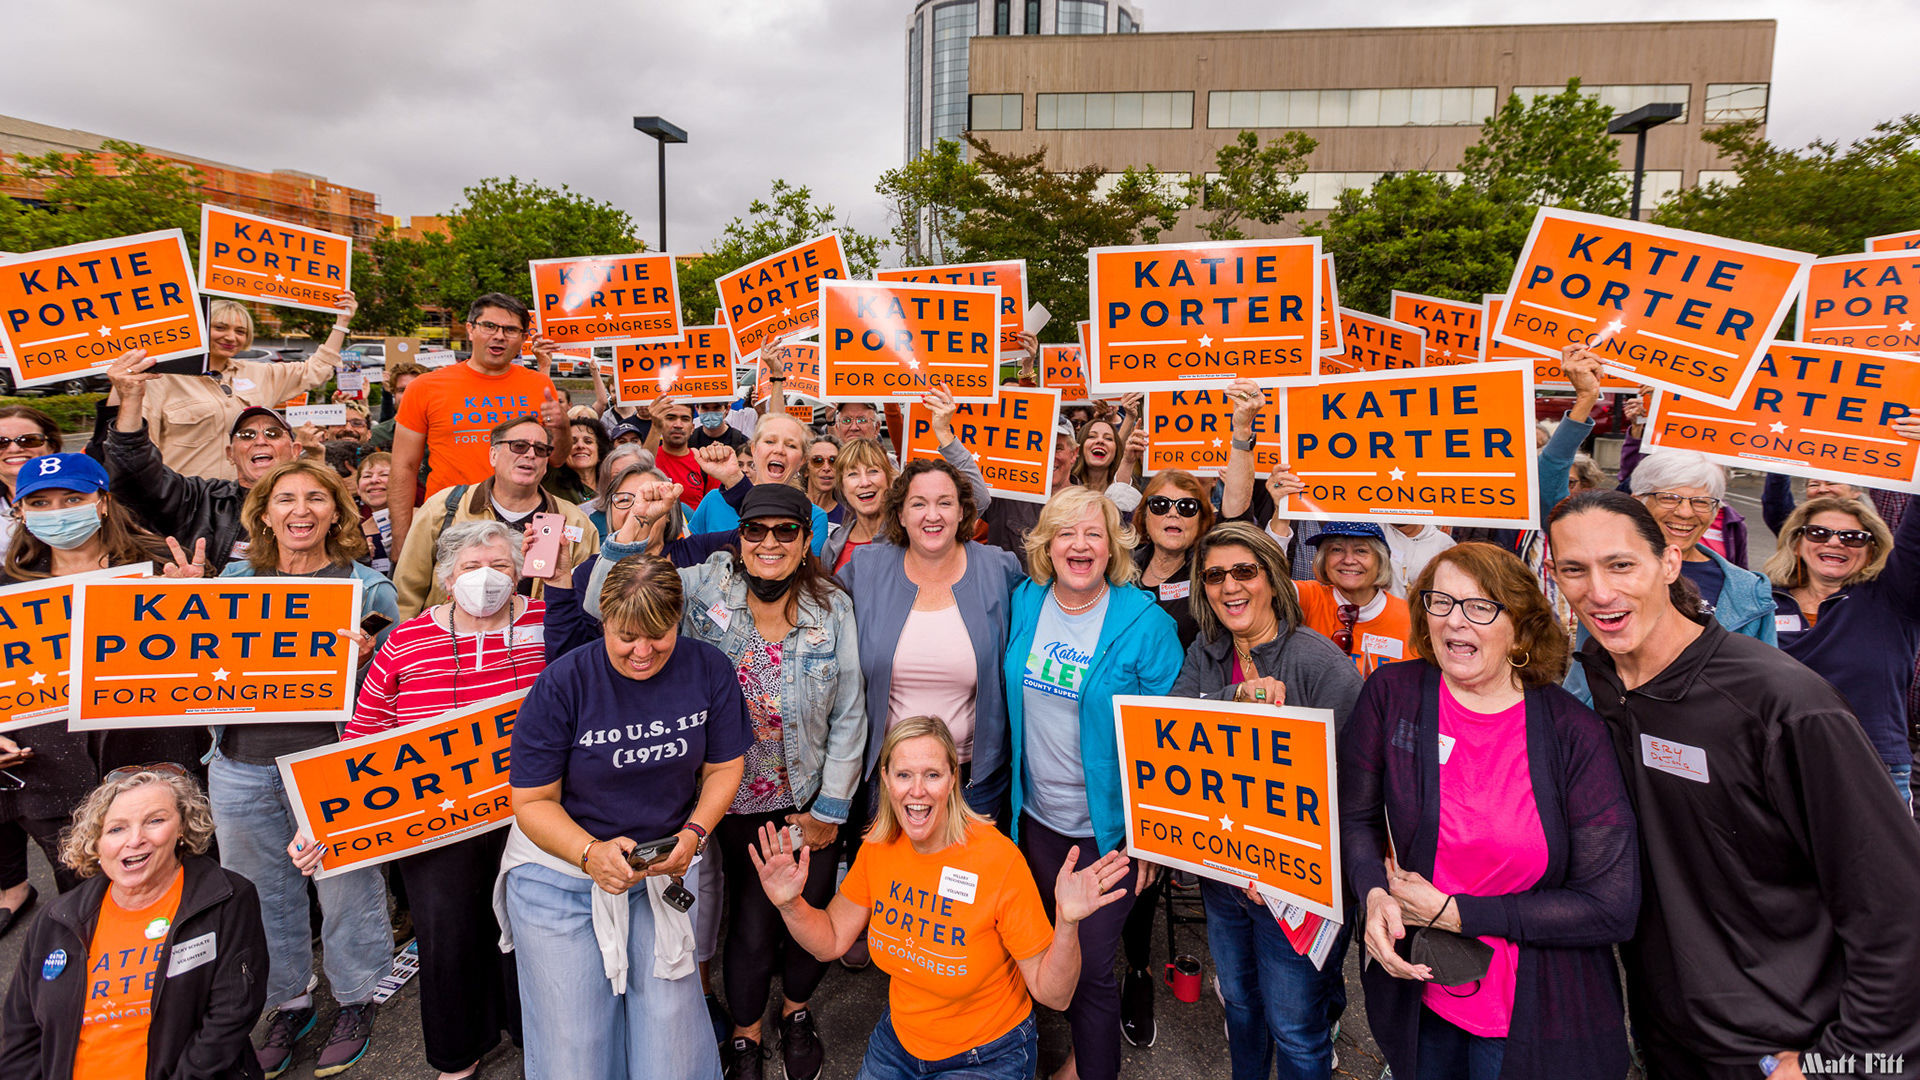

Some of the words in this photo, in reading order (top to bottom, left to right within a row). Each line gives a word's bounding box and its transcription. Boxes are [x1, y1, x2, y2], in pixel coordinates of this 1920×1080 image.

[234, 222, 326, 256] KATIE
[20, 252, 152, 295] KATIE
[214, 241, 341, 281] PORTER
[558, 263, 650, 285] KATIE
[739, 249, 819, 293] KATIE
[1134, 255, 1278, 288] KATIE
[1568, 233, 1744, 293] KATIE
[212, 273, 246, 288] FOR
[254, 281, 340, 303] CONGRESS
[545, 286, 670, 311] PORTER
[732, 267, 838, 322] PORTER
[1527, 261, 1755, 342] PORTER
[8, 282, 184, 333] PORTER
[857, 295, 970, 322] KATIE
[1108, 294, 1305, 329] PORTER
[1414, 304, 1476, 329] KATI
[1814, 294, 1909, 319] POR
[548, 325, 580, 336] FOR
[585, 318, 673, 334] CONGRESS
[740, 329, 763, 347] FOR
[767, 308, 819, 334] CONGR
[835, 328, 988, 354] PORTER
[1347, 322, 1402, 351] ATIE
[24, 350, 68, 368] FOR
[76, 326, 191, 358] CONGRESS
[782, 347, 814, 360] ATI
[1109, 353, 1157, 370] FOR
[1167, 348, 1303, 368] CONGRESS
[1513, 313, 1558, 337] FOR
[1567, 328, 1729, 383] CONGRESS
[622, 353, 726, 373] PORTER
[760, 362, 819, 379] PRTE
[1757, 353, 1886, 388] ATIE
[624, 385, 649, 395] FOR
[654, 380, 728, 394] CONGRESS
[782, 381, 819, 393] ONGRE
[835, 372, 874, 386] FOR
[883, 372, 988, 388] CONGRESS
[464, 396, 529, 408] KATIE
[956, 398, 1029, 420] ATIE
[1322, 384, 1479, 420] KATIE
[1753, 387, 1912, 426] RTER
[915, 419, 1044, 452] PRTER
[1155, 413, 1280, 433] PORTE
[455, 434, 478, 444] FOR
[1297, 428, 1515, 459] PORTER
[1663, 422, 1717, 442] FOR
[1730, 431, 1903, 468] CONGRESS
[39, 457, 62, 476] B
[1154, 451, 1184, 462] FOR
[982, 466, 1040, 484] GRESS
[1299, 485, 1346, 501] FOR
[1357, 485, 1516, 506] CONGRESS
[0, 594, 72, 629] ATI
[133, 592, 310, 621] KATIE
[95, 630, 338, 662] PORTER
[93, 687, 157, 706] FOR
[171, 682, 334, 702] CONGRESS
[1023, 679, 1052, 692] COUNTY
[579, 729, 622, 747] 410
[625, 720, 672, 741] U.S.
[676, 709, 708, 731] 113
[1154, 718, 1293, 767] KATIE
[344, 709, 518, 783] KATIE
[612, 737, 688, 769] (1973)
[319, 746, 511, 823] PORTE
[1135, 759, 1321, 827] PORTER
[332, 831, 394, 857] FOR
[406, 795, 511, 838] CONGR
[1140, 819, 1183, 845] FOR
[1192, 831, 1322, 886] CONGRESS
[889, 880, 954, 917] KATIE
[873, 899, 966, 946] PORTER
[91, 943, 164, 973] ATIE
[869, 936, 884, 951] OR
[887, 944, 968, 977] CONGRESS
[91, 971, 156, 1000] RTE
[82, 1007, 150, 1025] CONGR
